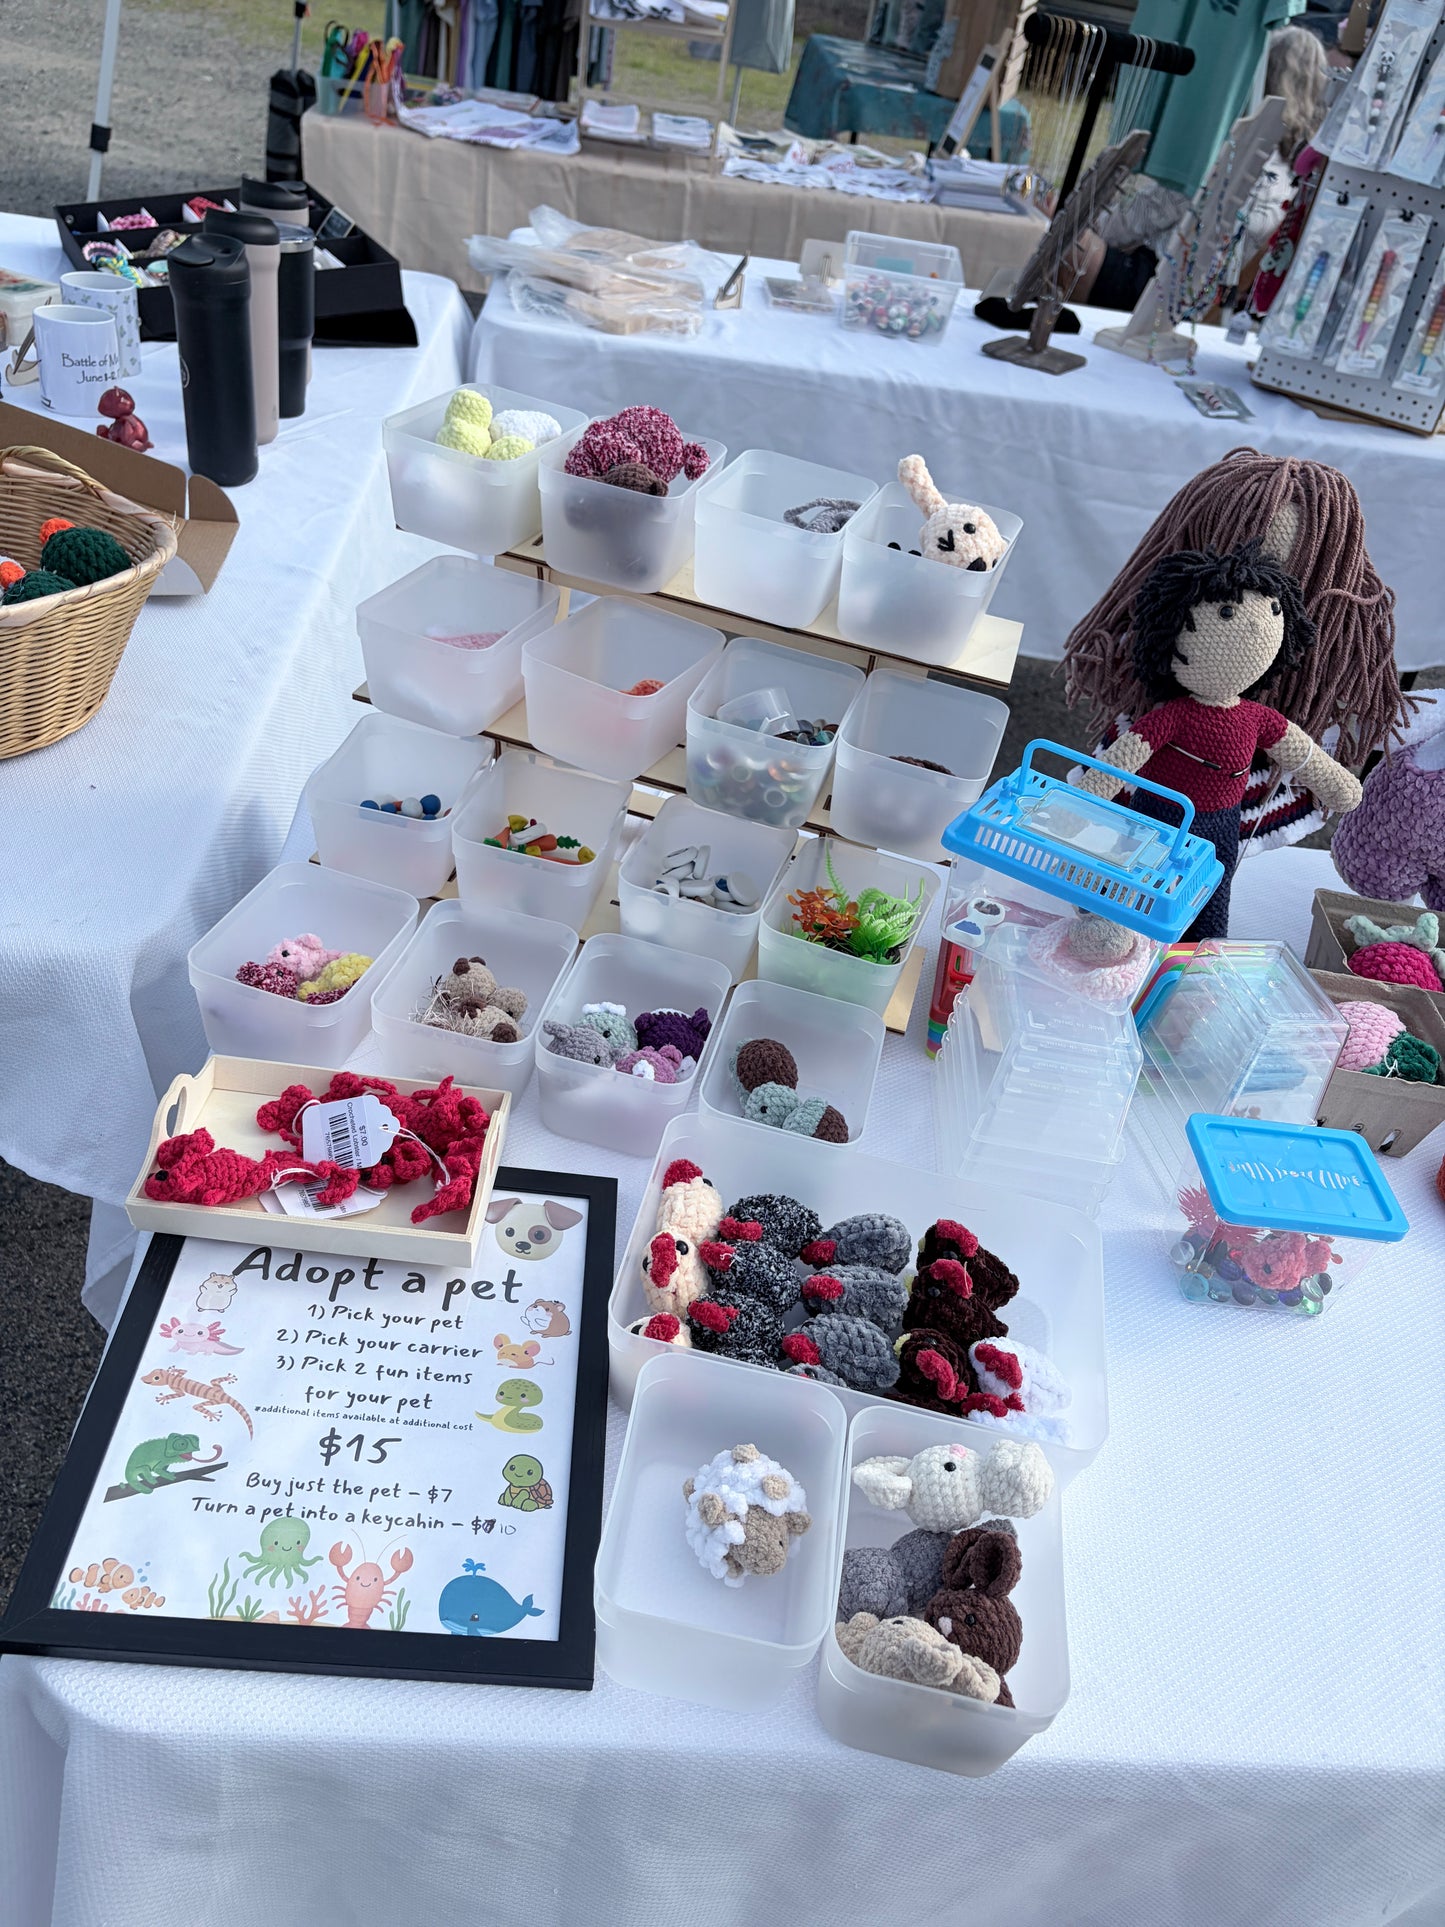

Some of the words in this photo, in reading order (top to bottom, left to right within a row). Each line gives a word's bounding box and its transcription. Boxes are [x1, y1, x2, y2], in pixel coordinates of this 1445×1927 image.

[61, 353, 97, 368] Battle
[98, 353, 108, 367] of
[76, 370, 104, 384] June
[346, 1101, 358, 1134] Crocheted
[352, 1133, 361, 1158] Lobster
[359, 1124, 369, 1147] $7.00
[232, 1246, 384, 1302] Adopt
[401, 1271, 426, 1294] a
[441, 1268, 524, 1312] pet
[307, 1303, 326, 1321] 1)
[330, 1305, 375, 1322] Pick
[380, 1310, 427, 1330] your
[429, 1314, 465, 1334] pet
[276, 1328, 300, 1345] 2)
[304, 1329, 350, 1347] Pick
[357, 1335, 402, 1354] your
[406, 1342, 484, 1359] carrier
[275, 1355, 296, 1371] 3)
[300, 1356, 348, 1374] Pick
[354, 1361, 368, 1376] 2
[375, 1364, 410, 1381] fun
[415, 1366, 473, 1385] items
[304, 1385, 340, 1404] for
[345, 1389, 393, 1409] your
[396, 1392, 434, 1414] pet
[312, 1409, 340, 1420] items
[341, 1412, 387, 1425] available
[388, 1416, 401, 1426] at
[402, 1417, 451, 1431] additional
[452, 1422, 475, 1432] cost
[318, 1426, 403, 1467] $15
[246, 1471, 282, 1496] Buy
[284, 1476, 327, 1498] just
[332, 1478, 365, 1496] the
[369, 1482, 402, 1503] pet
[427, 1485, 453, 1504] $7
[192, 1497, 239, 1515] Turn
[244, 1504, 257, 1516] a
[260, 1501, 296, 1523] pet
[300, 1504, 339, 1522] into
[344, 1511, 356, 1524] a
[361, 1507, 445, 1533] keycahin
[500, 1522, 517, 1536] 10
